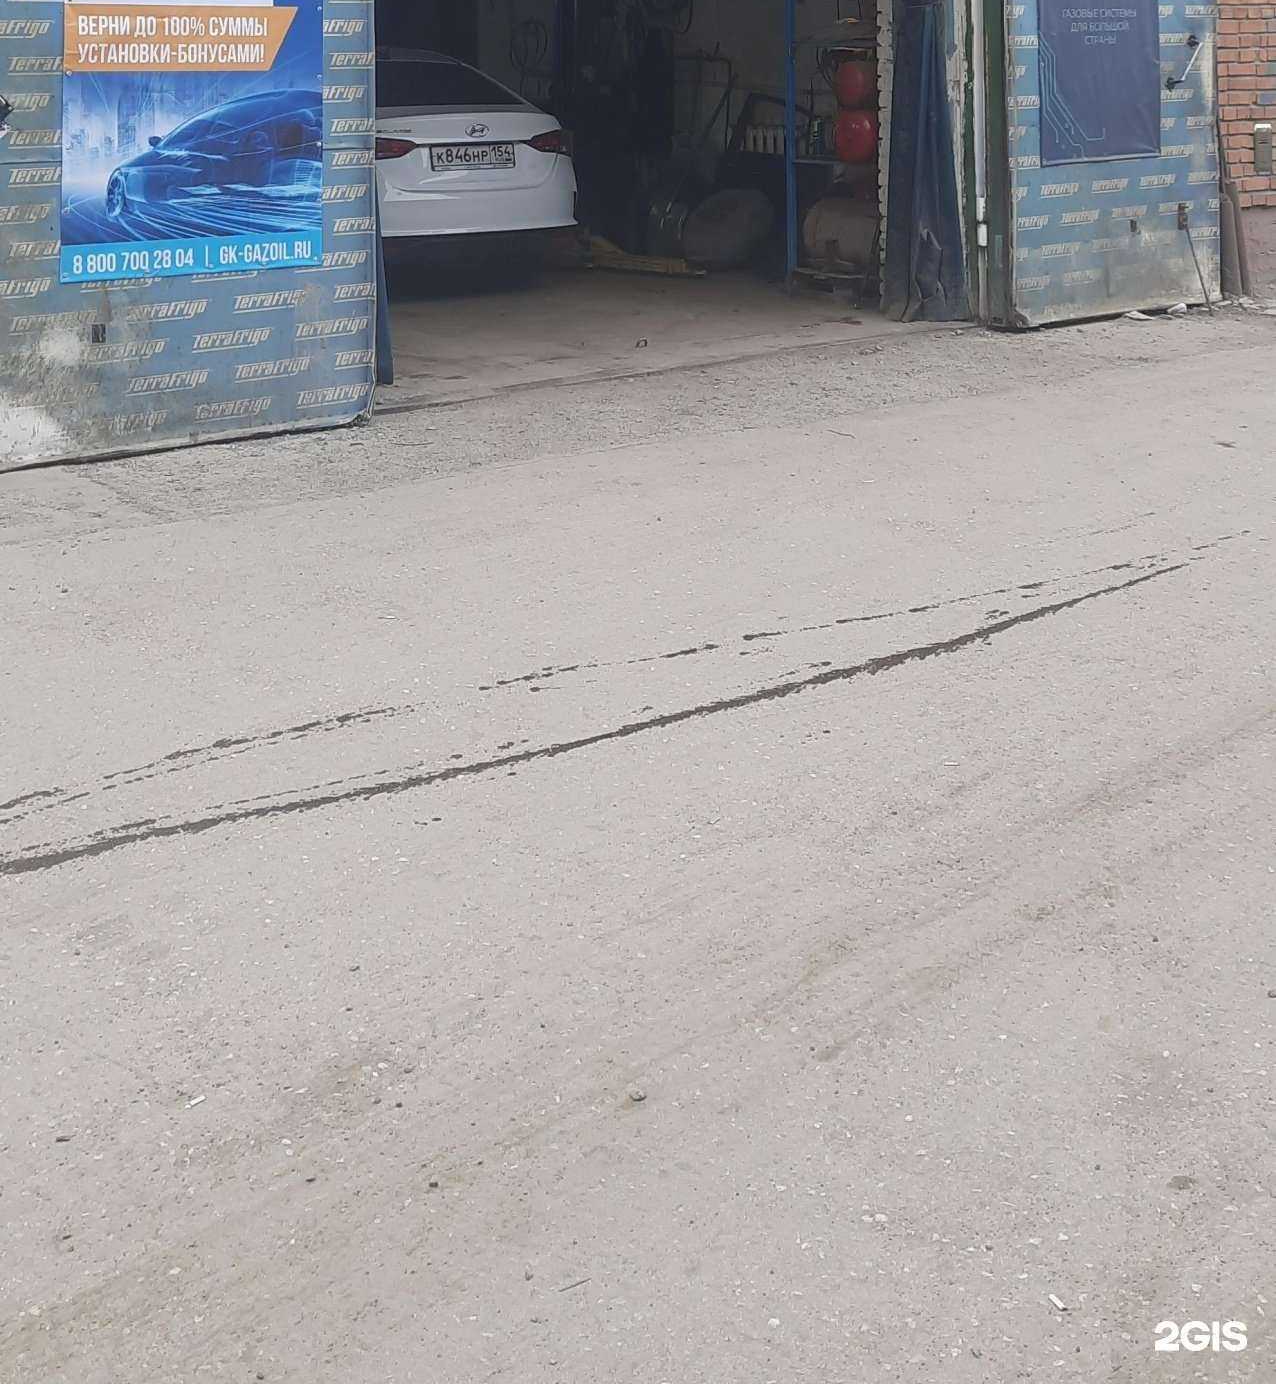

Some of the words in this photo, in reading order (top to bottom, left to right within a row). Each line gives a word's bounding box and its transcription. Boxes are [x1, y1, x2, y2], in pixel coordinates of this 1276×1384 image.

[78, 15, 131, 36] ВЕРНИ
[133, 16, 157, 39] ДО
[163, 17, 205, 36] 100%
[208, 17, 268, 36] СУММЫ
[78, 43, 265, 64] УСТАНОВКИ-БОНУСАМИ!
[491, 145, 511, 157] 154
[73, 255, 83, 274] 8
[86, 252, 117, 274] 800
[121, 251, 150, 272] 700
[153, 249, 172, 269] 28
[175, 247, 194, 268] 04
[219, 241, 312, 265] GK-GAZOIL.RU
